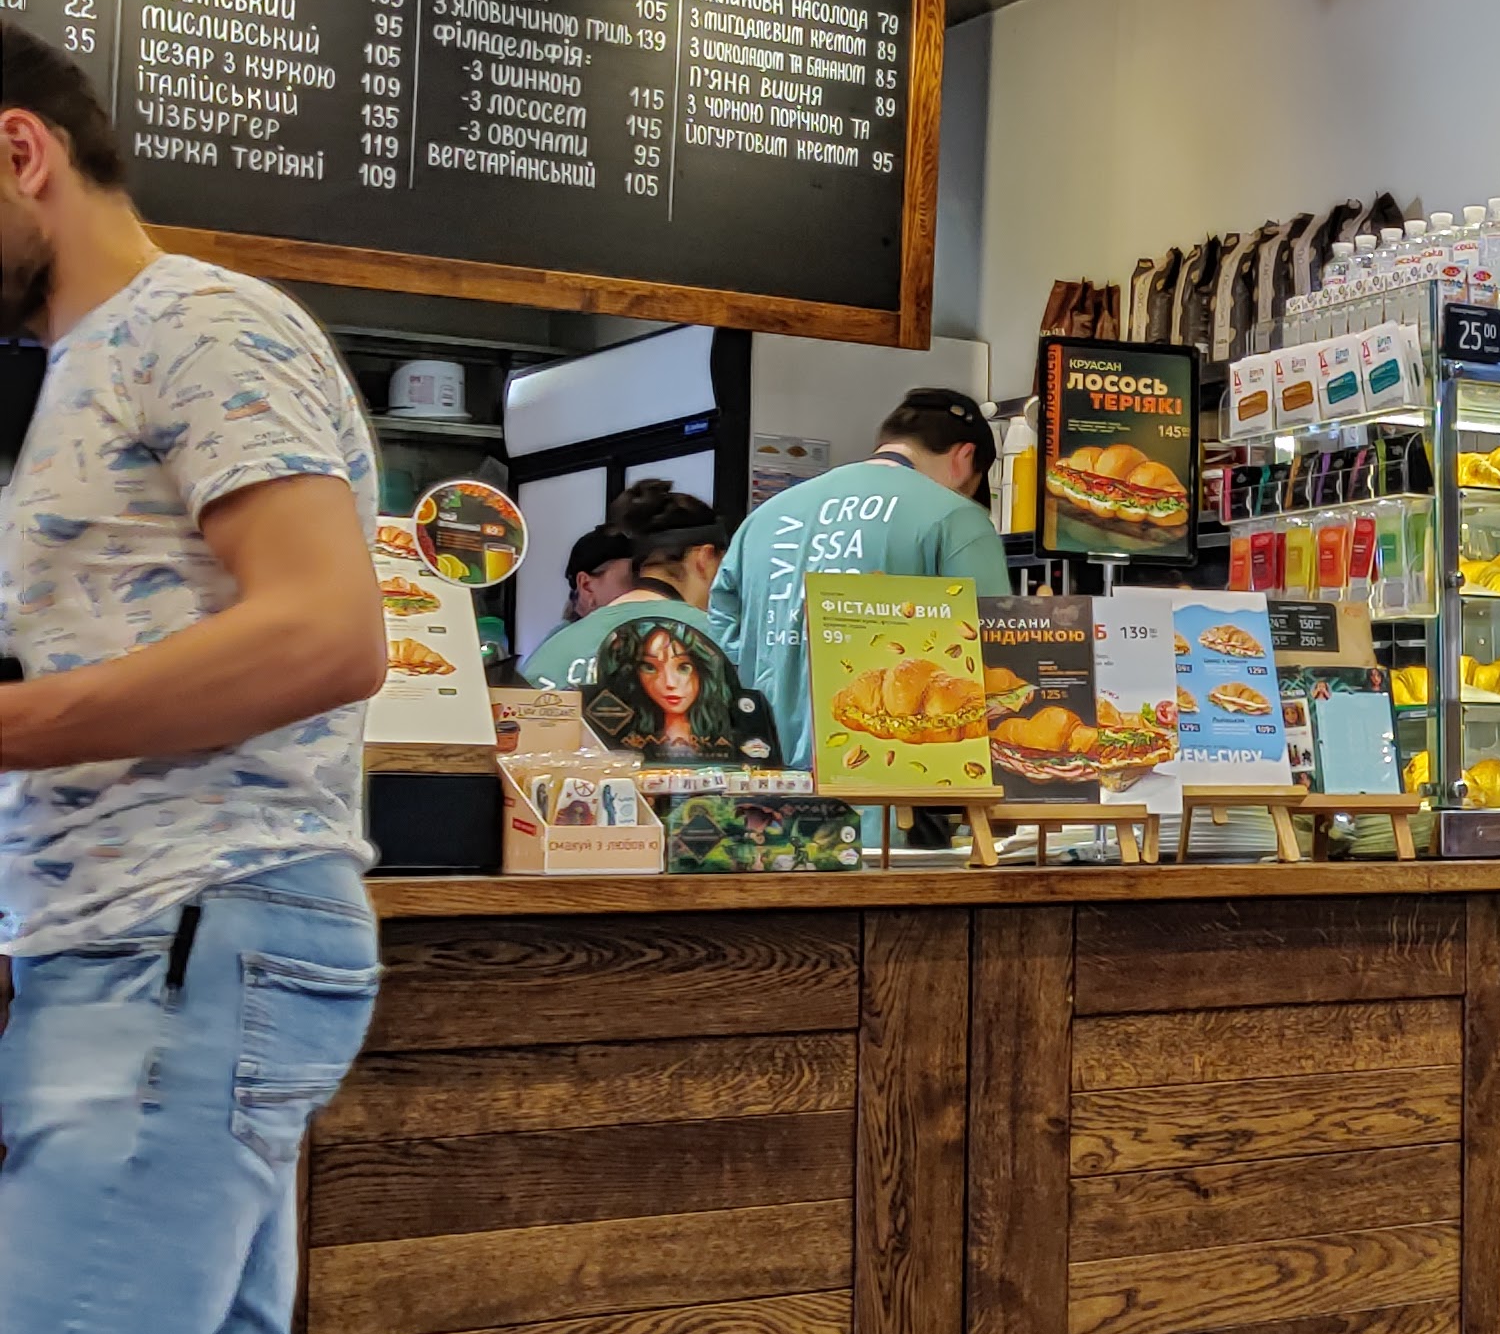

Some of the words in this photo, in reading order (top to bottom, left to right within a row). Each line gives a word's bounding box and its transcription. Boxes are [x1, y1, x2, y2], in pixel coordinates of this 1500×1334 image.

[374, 13, 404, 38] 95
[877, 10, 900, 36] 79
[64, 25, 96, 53] 35
[635, 27, 667, 52] 139
[876, 39, 897, 63] 89
[363, 42, 402, 68] 105
[360, 72, 402, 98] 109
[874, 68, 897, 91] 85
[629, 85, 665, 111] 115
[874, 95, 897, 119] 89
[361, 103, 401, 129] 135
[625, 114, 663, 141] 145
[361, 132, 400, 159] 119
[633, 143, 660, 168] 95
[871, 150, 895, 174] 95
[358, 162, 397, 189] 109
[623, 171, 660, 197] 105
[1459, 320, 1482, 351] 25
[1484, 323, 1497, 340] 00
[1069, 358, 1122, 372] КРУАСАН
[1066, 372, 1169, 396] ЛОСОСЬ
[1089, 392, 1184, 415] ТЕРІЯКІ
[1158, 425, 1182, 439] 145
[819, 496, 898, 525] CROI
[769, 515, 804, 601] LVIV
[808, 529, 864, 562] SSA
[821, 599, 952, 619] ФІСТАШКВИЙ
[822, 629, 844, 644] 99
[1119, 626, 1148, 639] 139
[1041, 689, 1062, 700] 125
